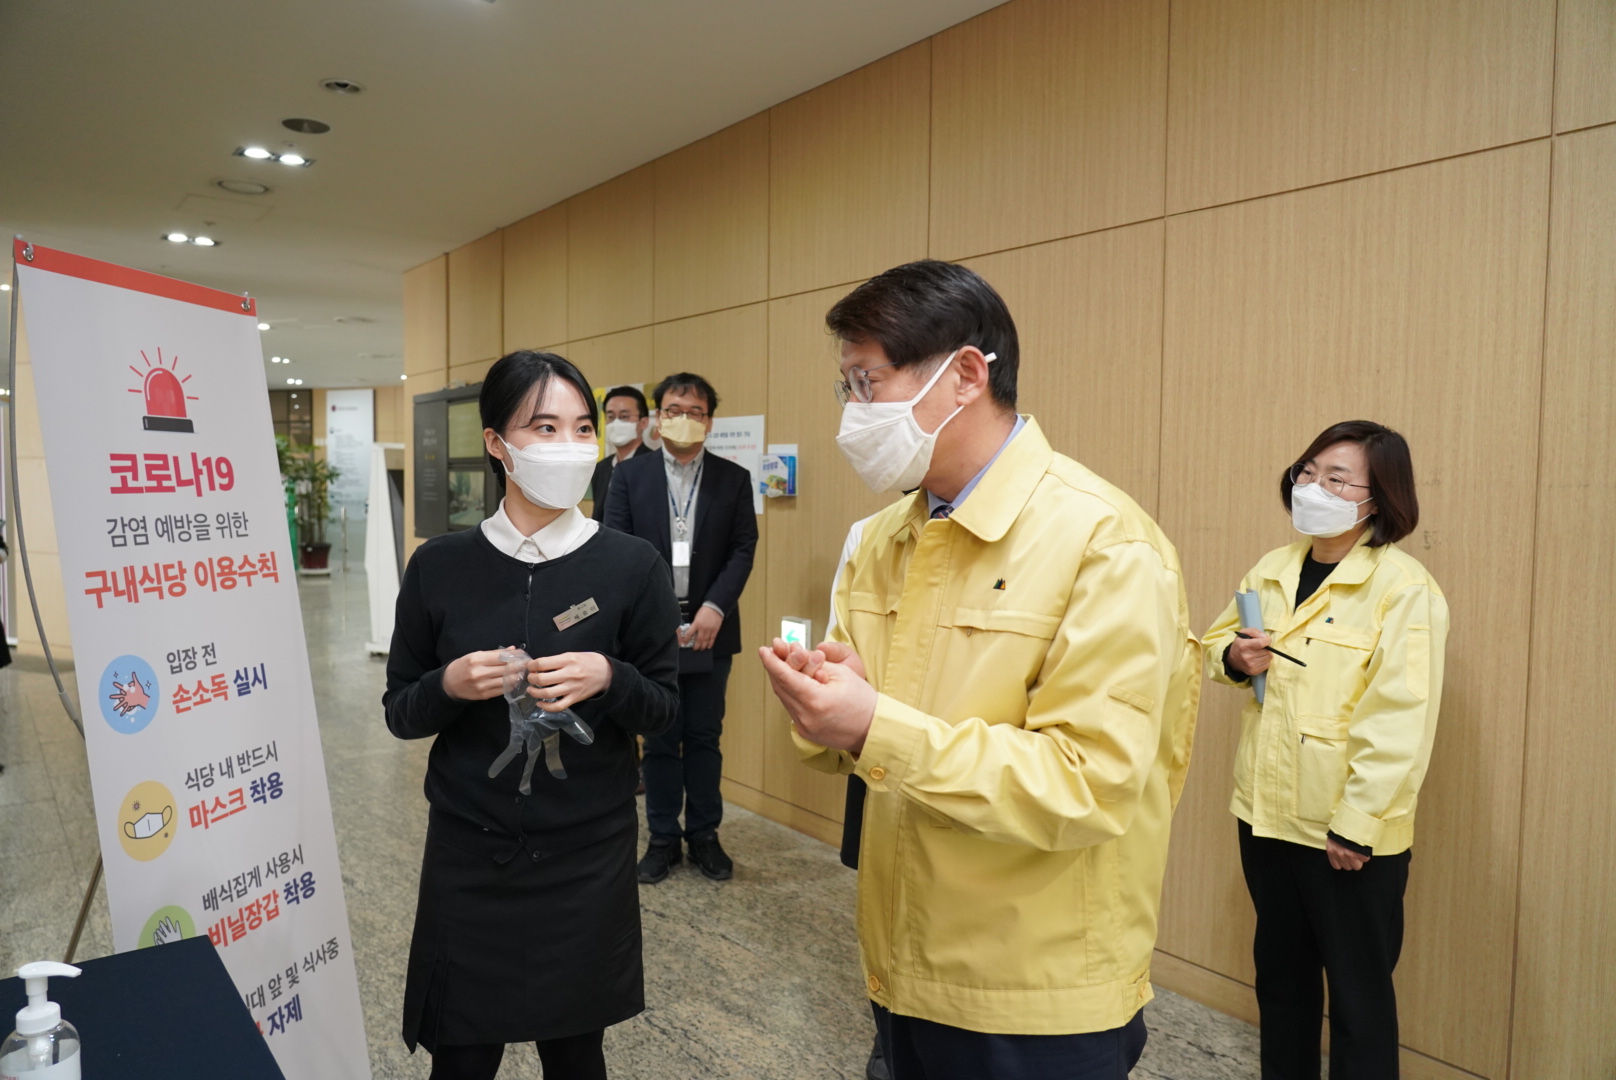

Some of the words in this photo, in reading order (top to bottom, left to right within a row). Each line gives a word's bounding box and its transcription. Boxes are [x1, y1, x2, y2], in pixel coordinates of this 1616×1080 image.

[109, 452, 235, 497] 코로나19
[106, 515, 150, 548] 감염
[154, 513, 211, 544] 예방을
[215, 511, 249, 540] 위한
[84, 560, 187, 609] 구내식당
[193, 551, 280, 593] 이용수칙
[166, 646, 198, 675] 입장
[201, 642, 218, 667] 전
[172, 673, 229, 715] 손소독
[233, 662, 268, 697] 실시
[184, 762, 215, 792] 식당
[218, 755, 235, 779] 내
[236, 740, 279, 775] 반드시
[188, 787, 248, 830] 마스크
[249, 771, 284, 805] 착용
[201, 864, 263, 912] 배식집게
[265, 843, 305, 879] 사용시
[207, 888, 281, 948] 비닐장갑
[283, 871, 316, 906] 착용
[267, 973, 283, 1001] 앞
[285, 961, 300, 989] 및
[302, 936, 340, 973] 식사중
[266, 992, 303, 1037] 자제
